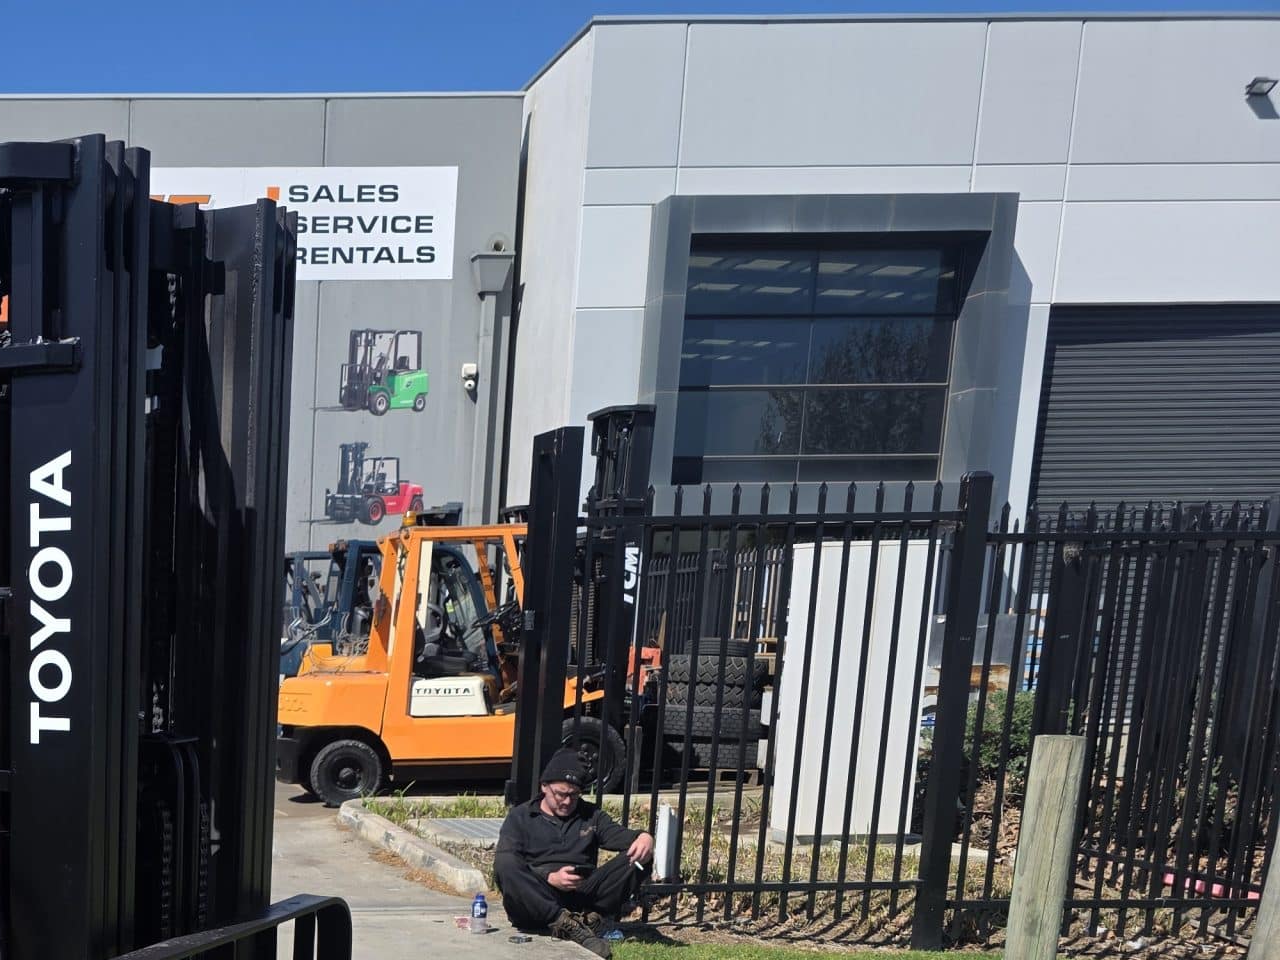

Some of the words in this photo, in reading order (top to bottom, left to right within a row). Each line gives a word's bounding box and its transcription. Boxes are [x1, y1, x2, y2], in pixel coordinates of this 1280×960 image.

[288, 184, 400, 203] SALES
[296, 215, 434, 234] SERVICE
[296, 245, 436, 264] RENTALS
[29, 450, 72, 744] TOYOTA
[415, 687, 471, 695] TOYOTA
